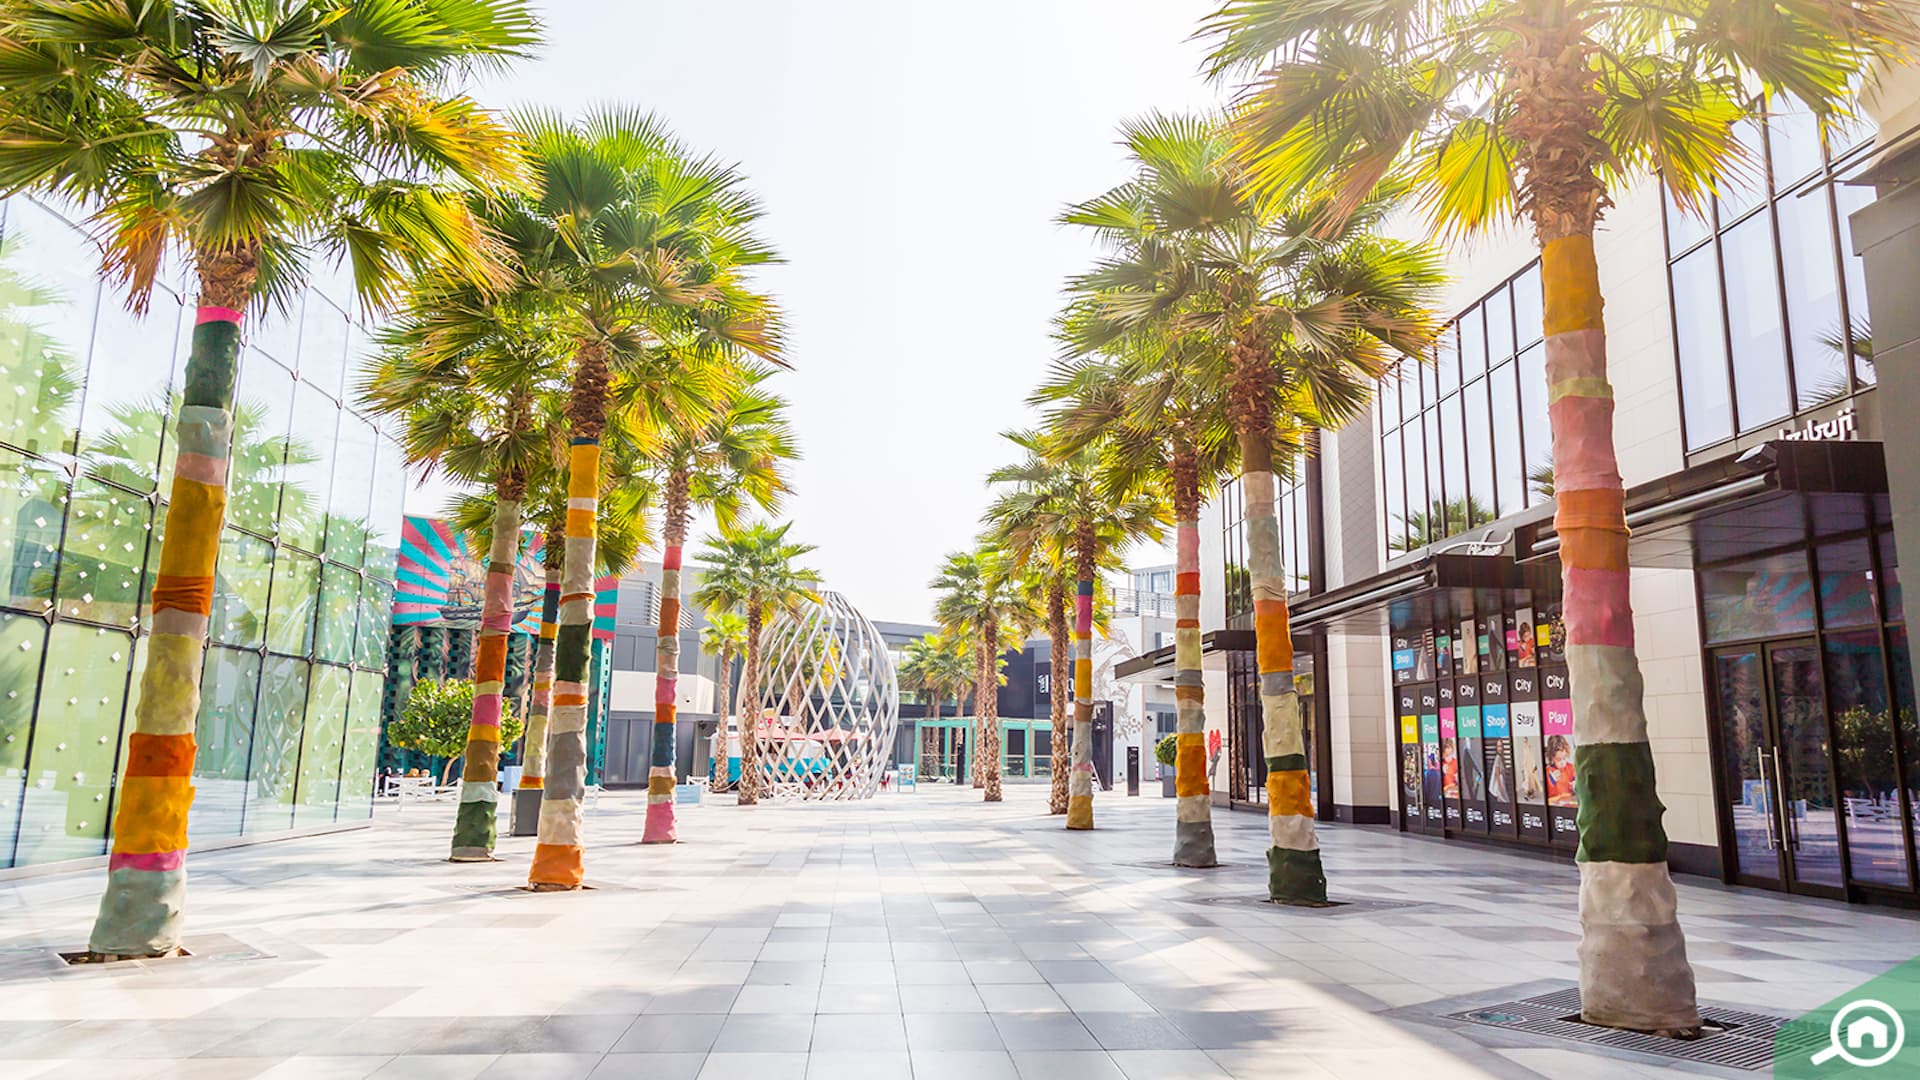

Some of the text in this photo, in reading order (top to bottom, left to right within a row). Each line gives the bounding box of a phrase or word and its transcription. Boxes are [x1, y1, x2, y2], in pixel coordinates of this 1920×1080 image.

[1486, 682, 1502, 697] City
[1515, 678, 1532, 693] City
[1546, 675, 1565, 690] City
[1440, 688, 1453, 702] City
[1460, 684, 1475, 698] City
[1402, 696, 1414, 709] City
[1423, 695, 1436, 708] City
[1441, 718, 1455, 731] Play
[1461, 716, 1477, 728] Live
[1486, 715, 1507, 728] Shop
[1516, 713, 1536, 728] Stay
[1548, 711, 1569, 727] Play
[1424, 723, 1437, 734] Find
